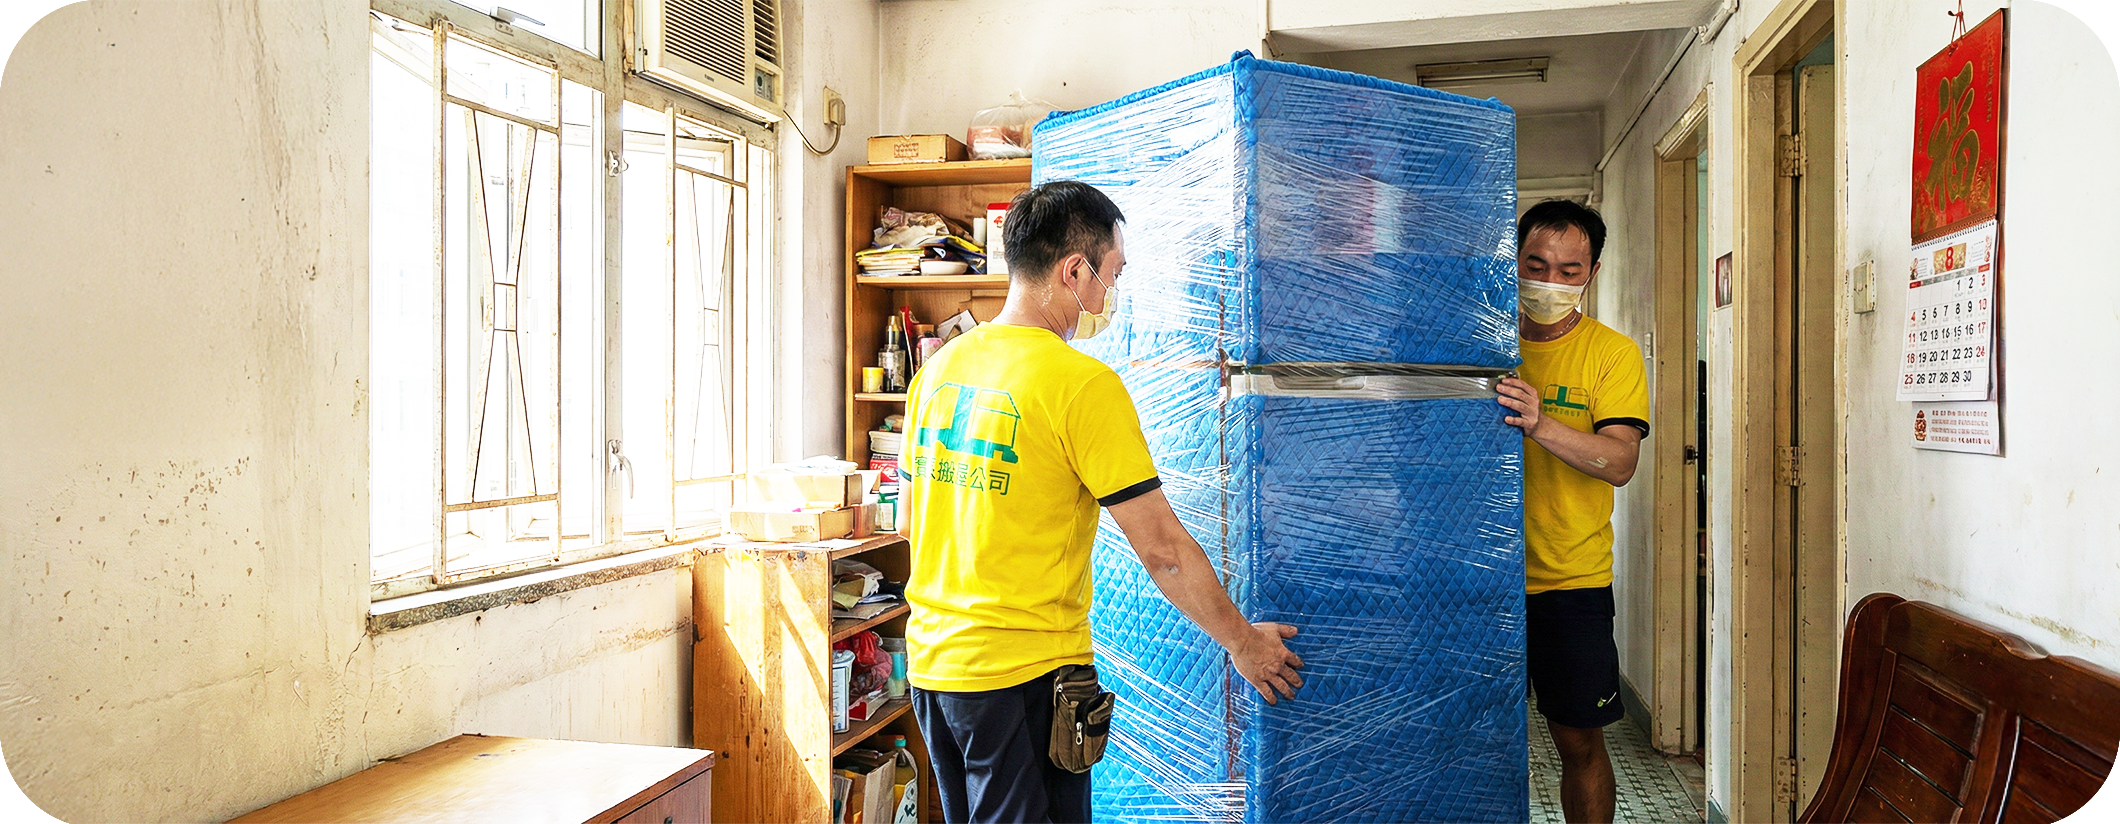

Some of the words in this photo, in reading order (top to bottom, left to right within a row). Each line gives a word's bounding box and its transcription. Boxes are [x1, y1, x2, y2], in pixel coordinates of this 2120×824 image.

[1924, 60, 1980, 212] 福
[1945, 246, 1954, 270] 8
[1957, 280, 1960, 291] 1
[1969, 277, 1973, 289] 2
[1981, 275, 1985, 286] 3
[1911, 312, 1916, 321] 4
[1922, 310, 1926, 320] 5
[1933, 308, 1937, 318] 6
[1944, 305, 1948, 316] 7
[1956, 303, 1960, 314] 8
[1968, 301, 1972, 312] 9
[1979, 299, 1987, 310] 10
[1909, 333, 1915, 343] 11
[1920, 331, 1927, 341] 12
[1931, 330, 1938, 340] 13
[1954, 326, 1961, 337] 15
[1965, 324, 1974, 335] 16
[1978, 322, 1986, 333] 17
[1907, 353, 1915, 363] 18
[1919, 352, 1926, 363] 19
[1929, 351, 1937, 362] 20
[1941, 350, 1948, 361] 21
[1952, 348, 1961, 360] 22
[1964, 347, 1972, 358] 23
[1905, 374, 1913, 384] 25
[1917, 374, 1925, 384] 26
[1928, 373, 1936, 383] 27
[1940, 372, 1948, 383] 28
[1952, 371, 1960, 382] 29
[1963, 370, 1971, 381] 30
